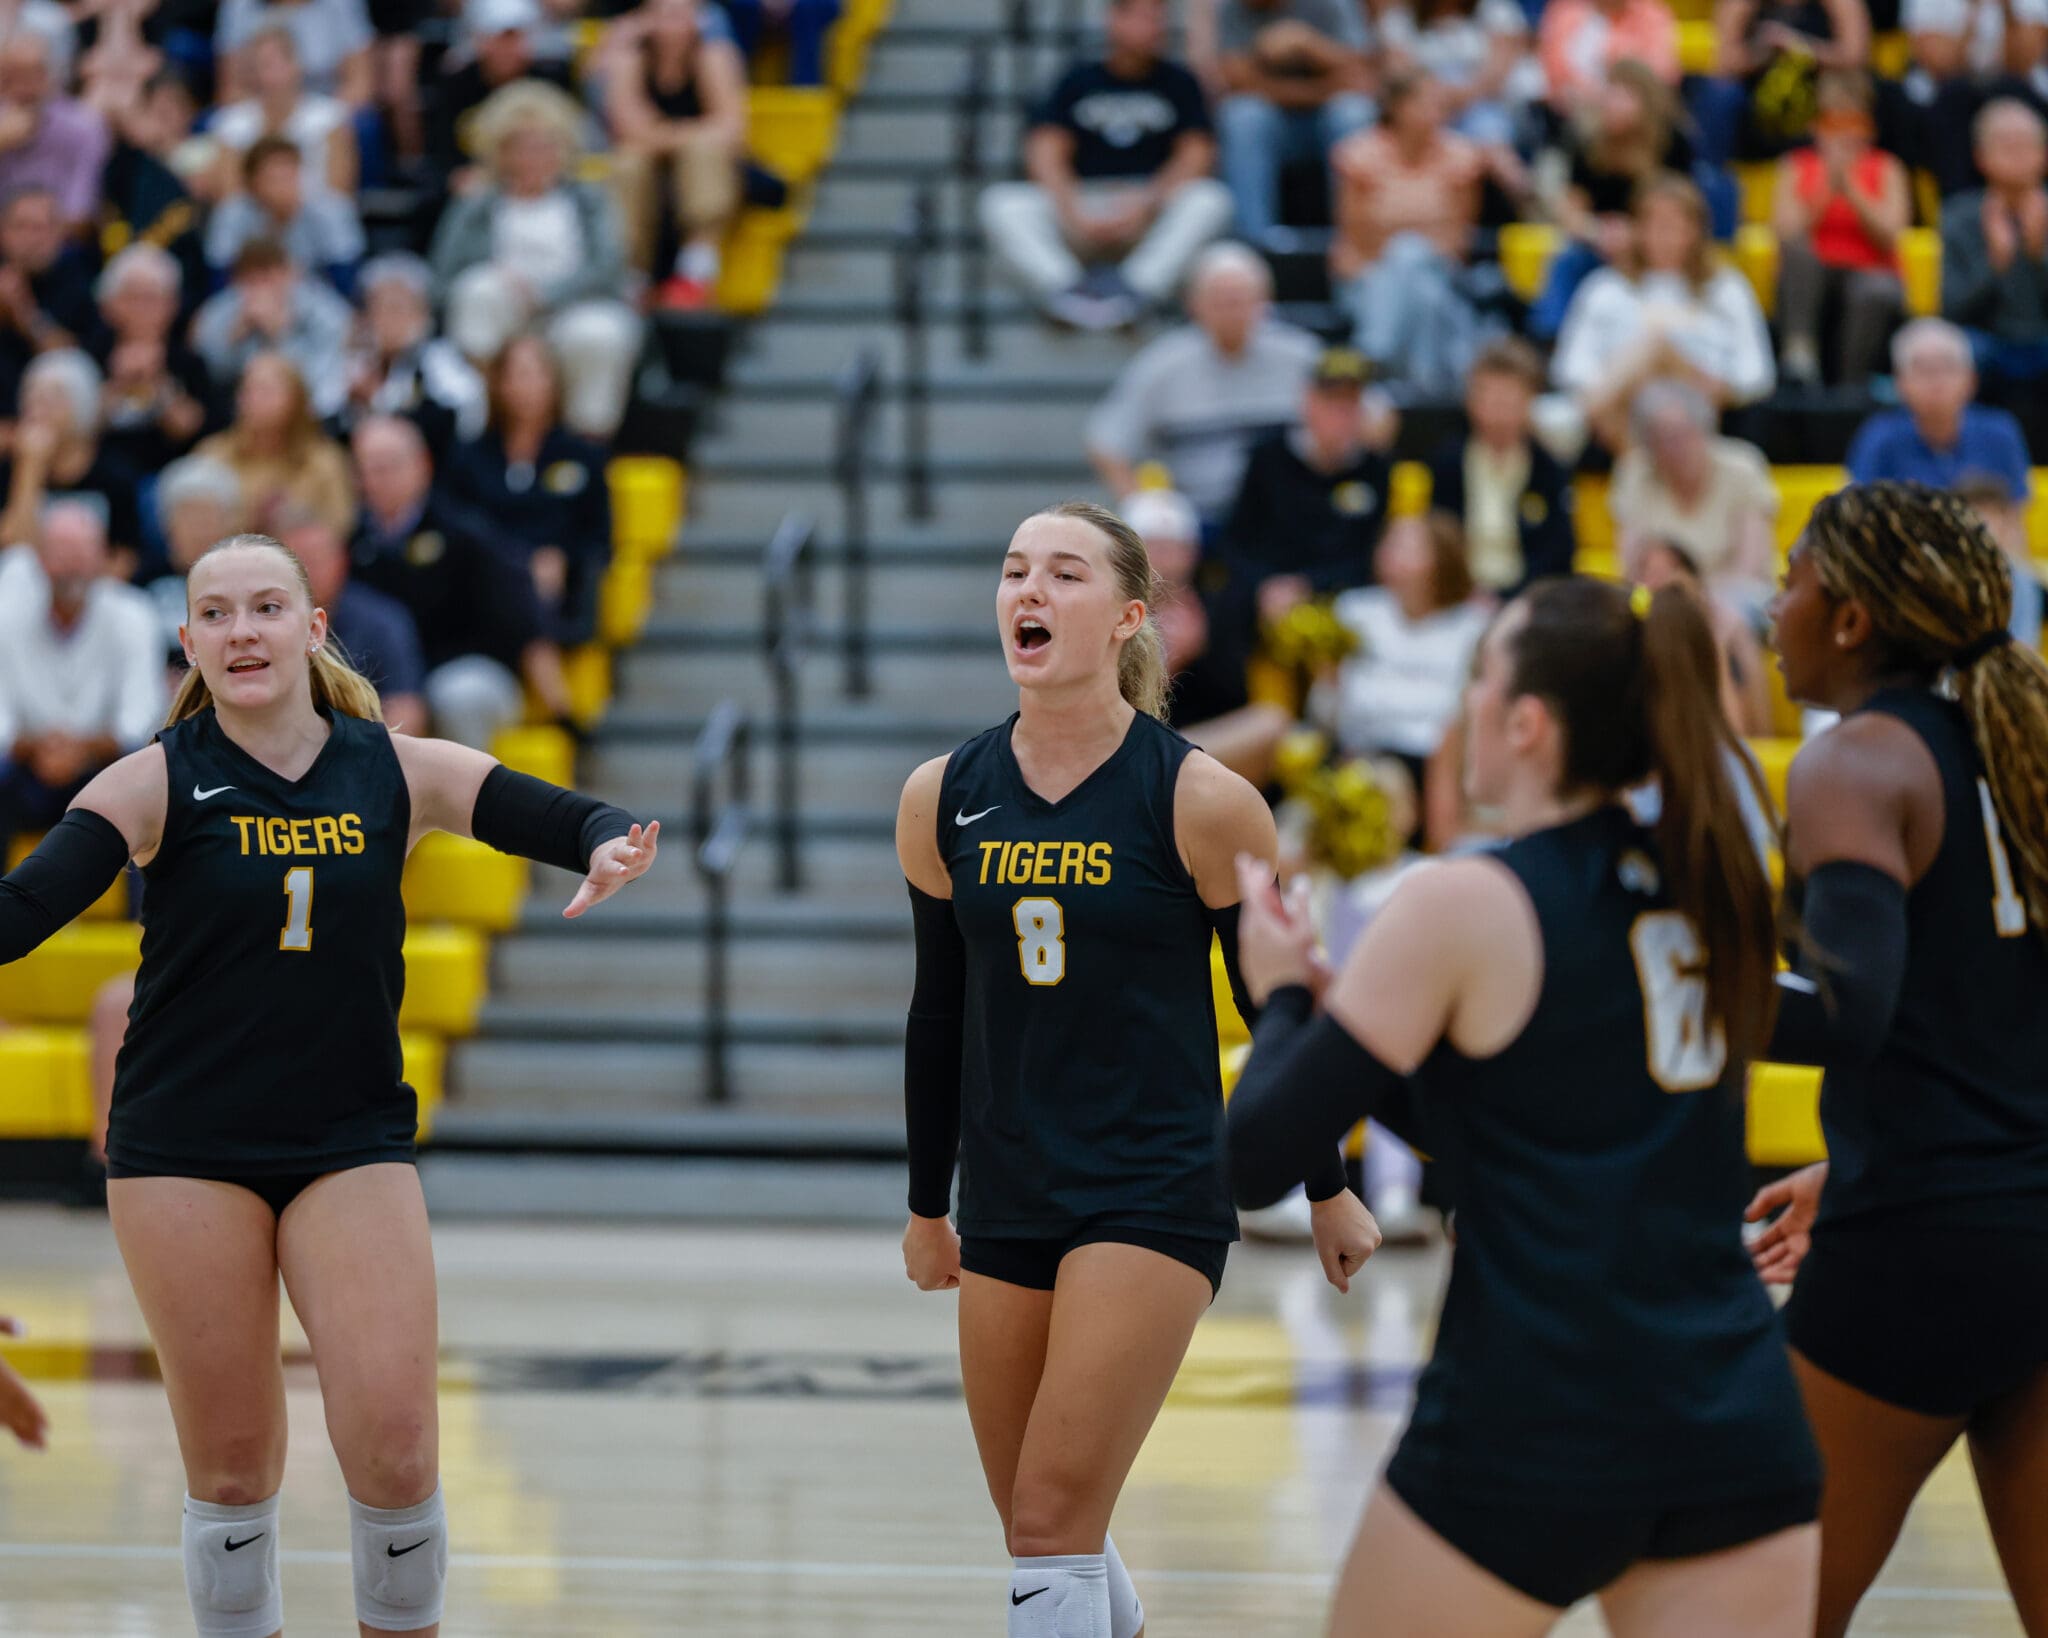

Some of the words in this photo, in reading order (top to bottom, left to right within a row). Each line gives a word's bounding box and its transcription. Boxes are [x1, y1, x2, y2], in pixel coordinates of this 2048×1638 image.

[230, 813, 365, 855] TIGERS
[978, 841, 1113, 885] TIGERS
[279, 866, 314, 951] 1
[1012, 896, 1066, 986] 8
[1628, 910, 1728, 1094] 6
